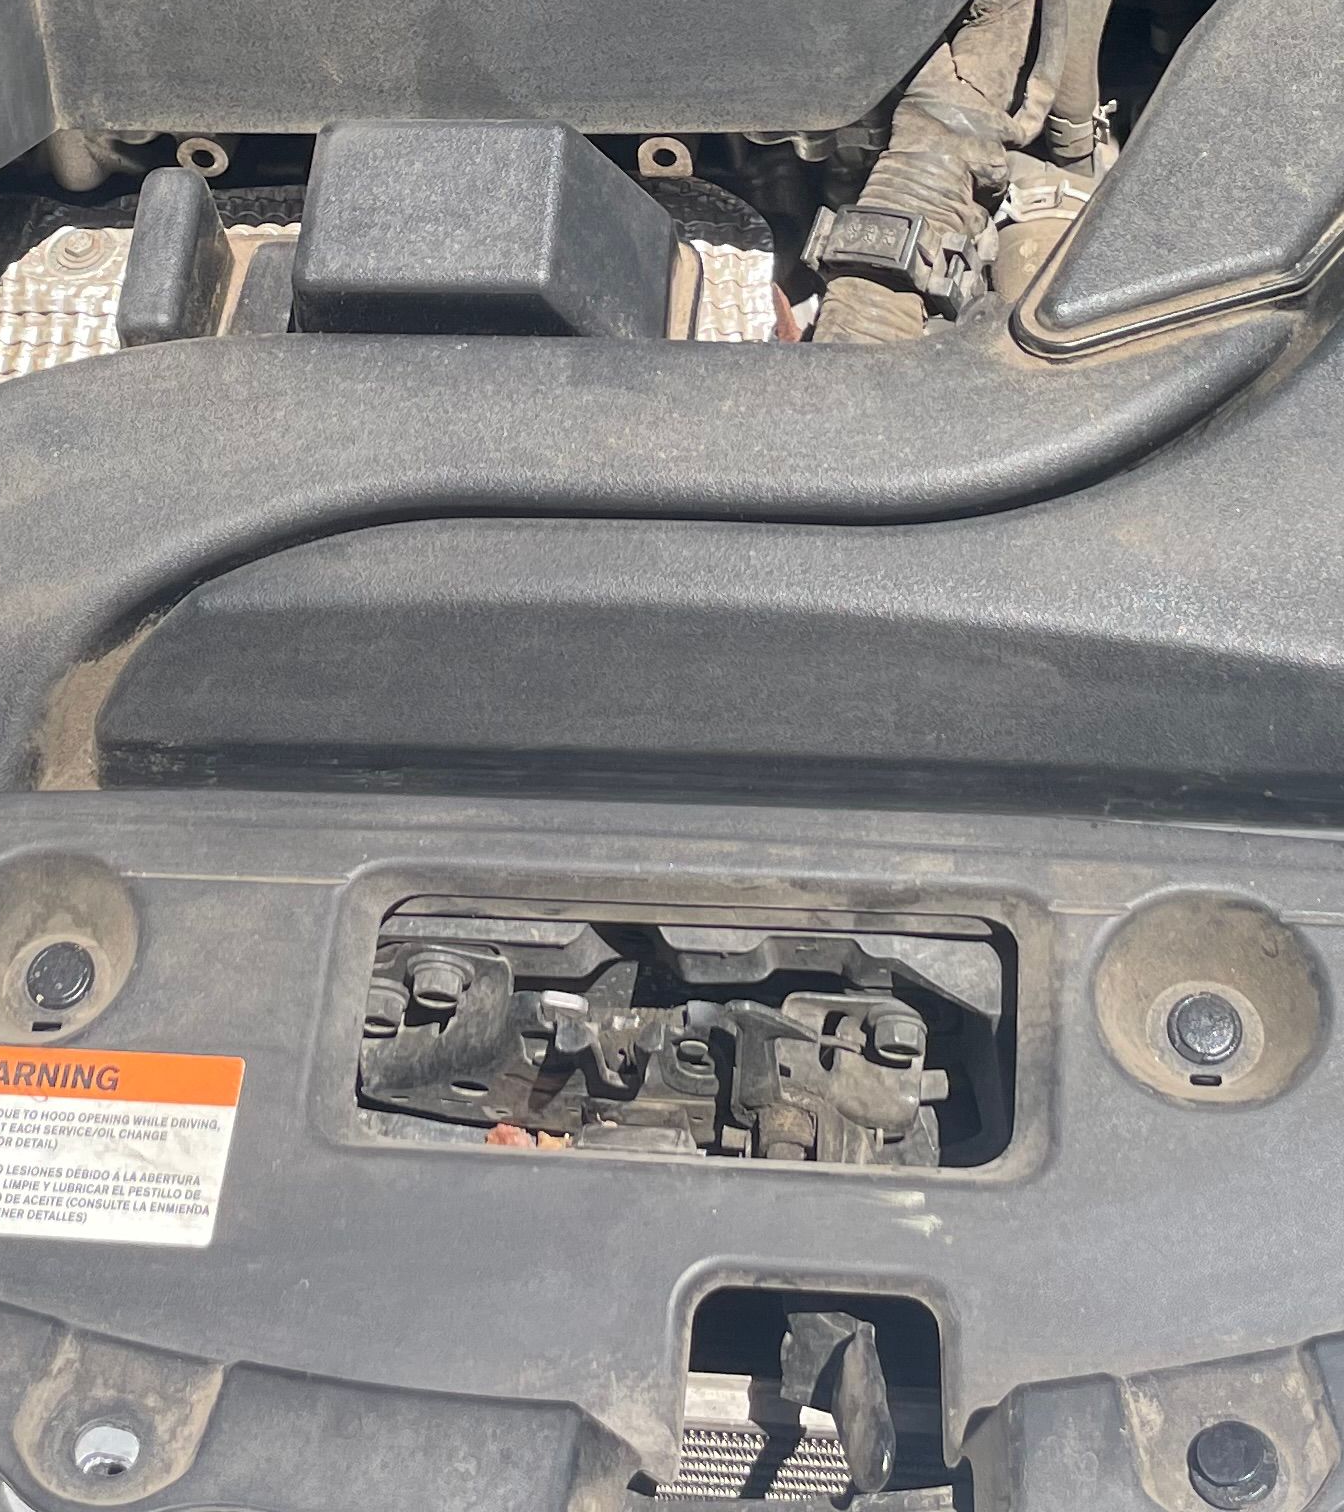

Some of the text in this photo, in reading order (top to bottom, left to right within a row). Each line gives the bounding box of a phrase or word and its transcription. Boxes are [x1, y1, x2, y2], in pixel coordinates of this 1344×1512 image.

[23, 1109, 39, 1120] TO
[40, 1111, 76, 1122] HOOD
[78, 1113, 130, 1126] OPENING
[133, 1115, 168, 1127] WHILE
[170, 1117, 221, 1132] DRIVING,
[9, 1123, 41, 1135] EACH
[43, 1125, 116, 1139] SERVICE/OIL
[118, 1129, 168, 1142] CHANGE
[15, 1137, 59, 1152] DETAIL)
[6, 1165, 63, 1178] LESIONES
[65, 1168, 110, 1181] DEBIDO
[122, 1172, 137, 1183] LA
[139, 1173, 201, 1186] ABERTURA
[3, 1179, 40, 1191] LIMPIE
[43, 1181, 51, 1191] Y
[53, 1182, 109, 1196] LUBRICAR
[111, 1185, 125, 1196] EL
[128, 1186, 182, 1200] PESTILLO
[184, 1190, 202, 1200] DE
[5, 1193, 21, 1204] DE
[22, 1195, 63, 1207] ACEITE
[65, 1197, 130, 1211] (CONSULTE
[133, 1201, 147, 1212] LA
[149, 1202, 210, 1216] ENMIENDA
[26, 1210, 87, 1224] DETALLES)
